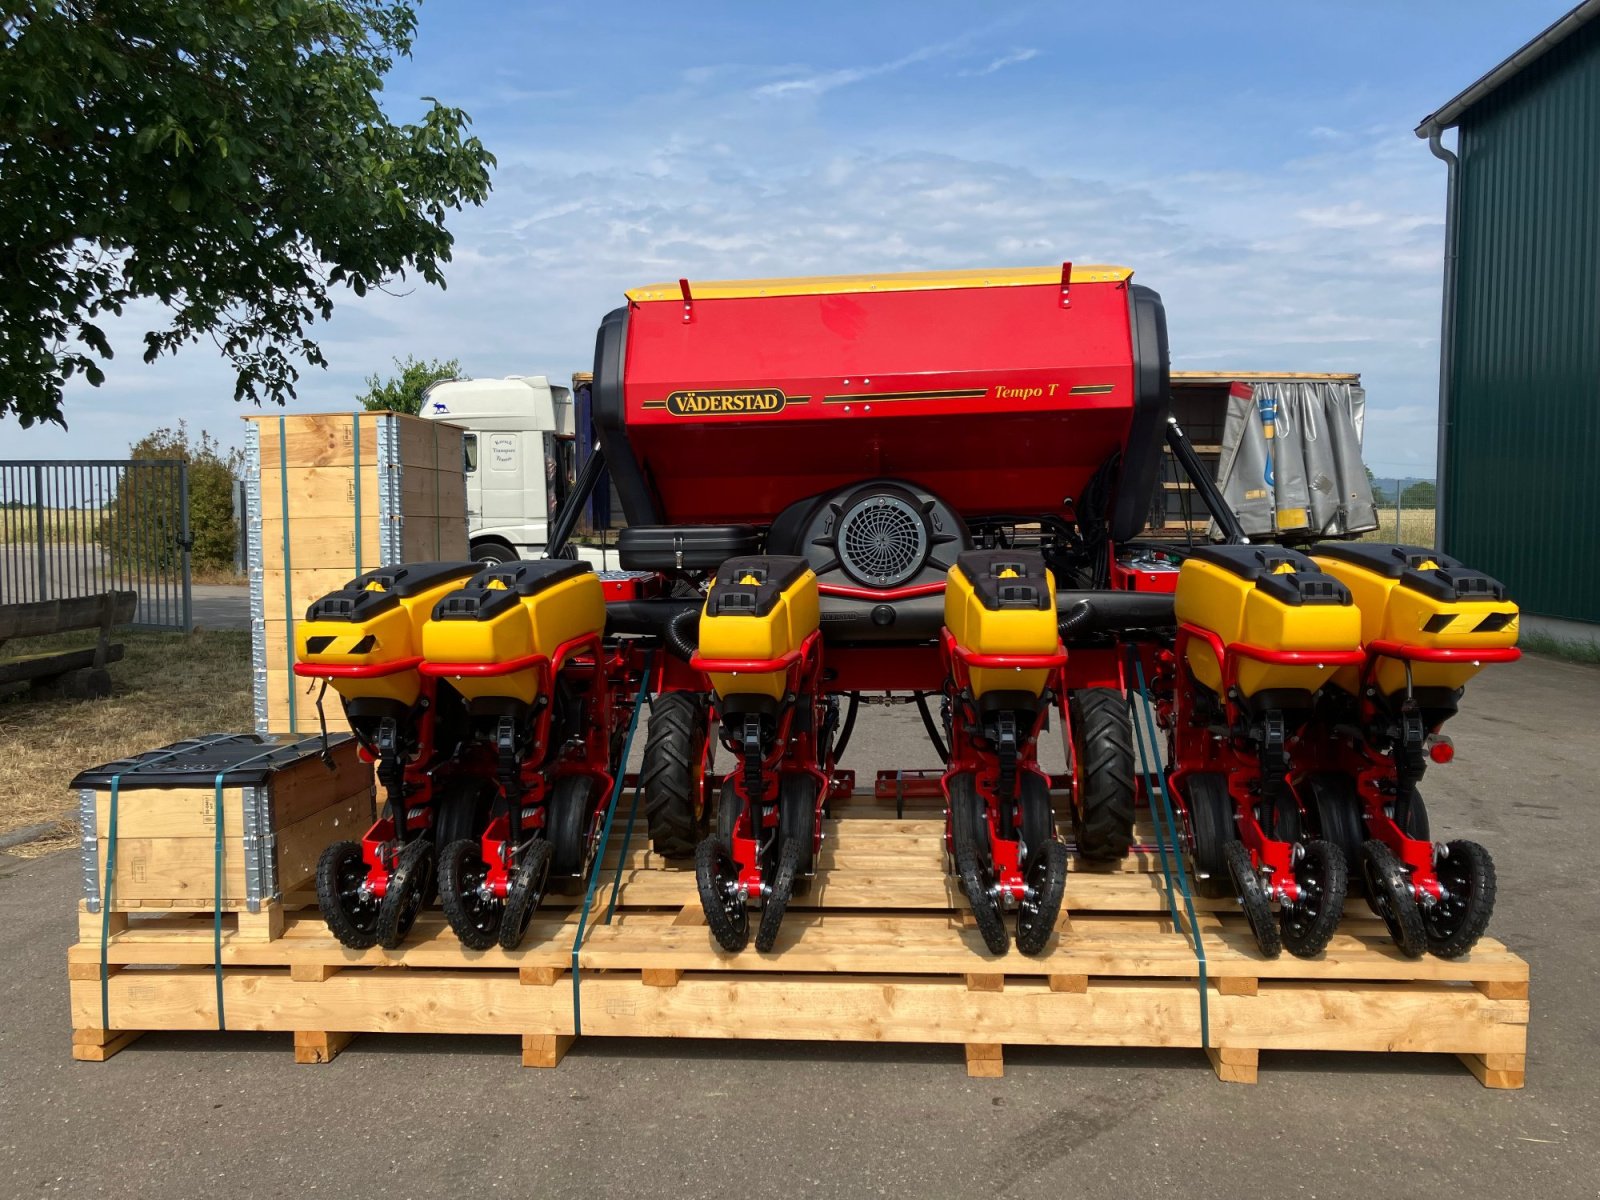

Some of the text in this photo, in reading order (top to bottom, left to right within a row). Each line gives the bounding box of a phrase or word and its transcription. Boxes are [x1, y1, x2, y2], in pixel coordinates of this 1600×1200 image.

[995, 384, 1060, 401] Tempo T
[675, 393, 778, 412] VÄDERSTAD
